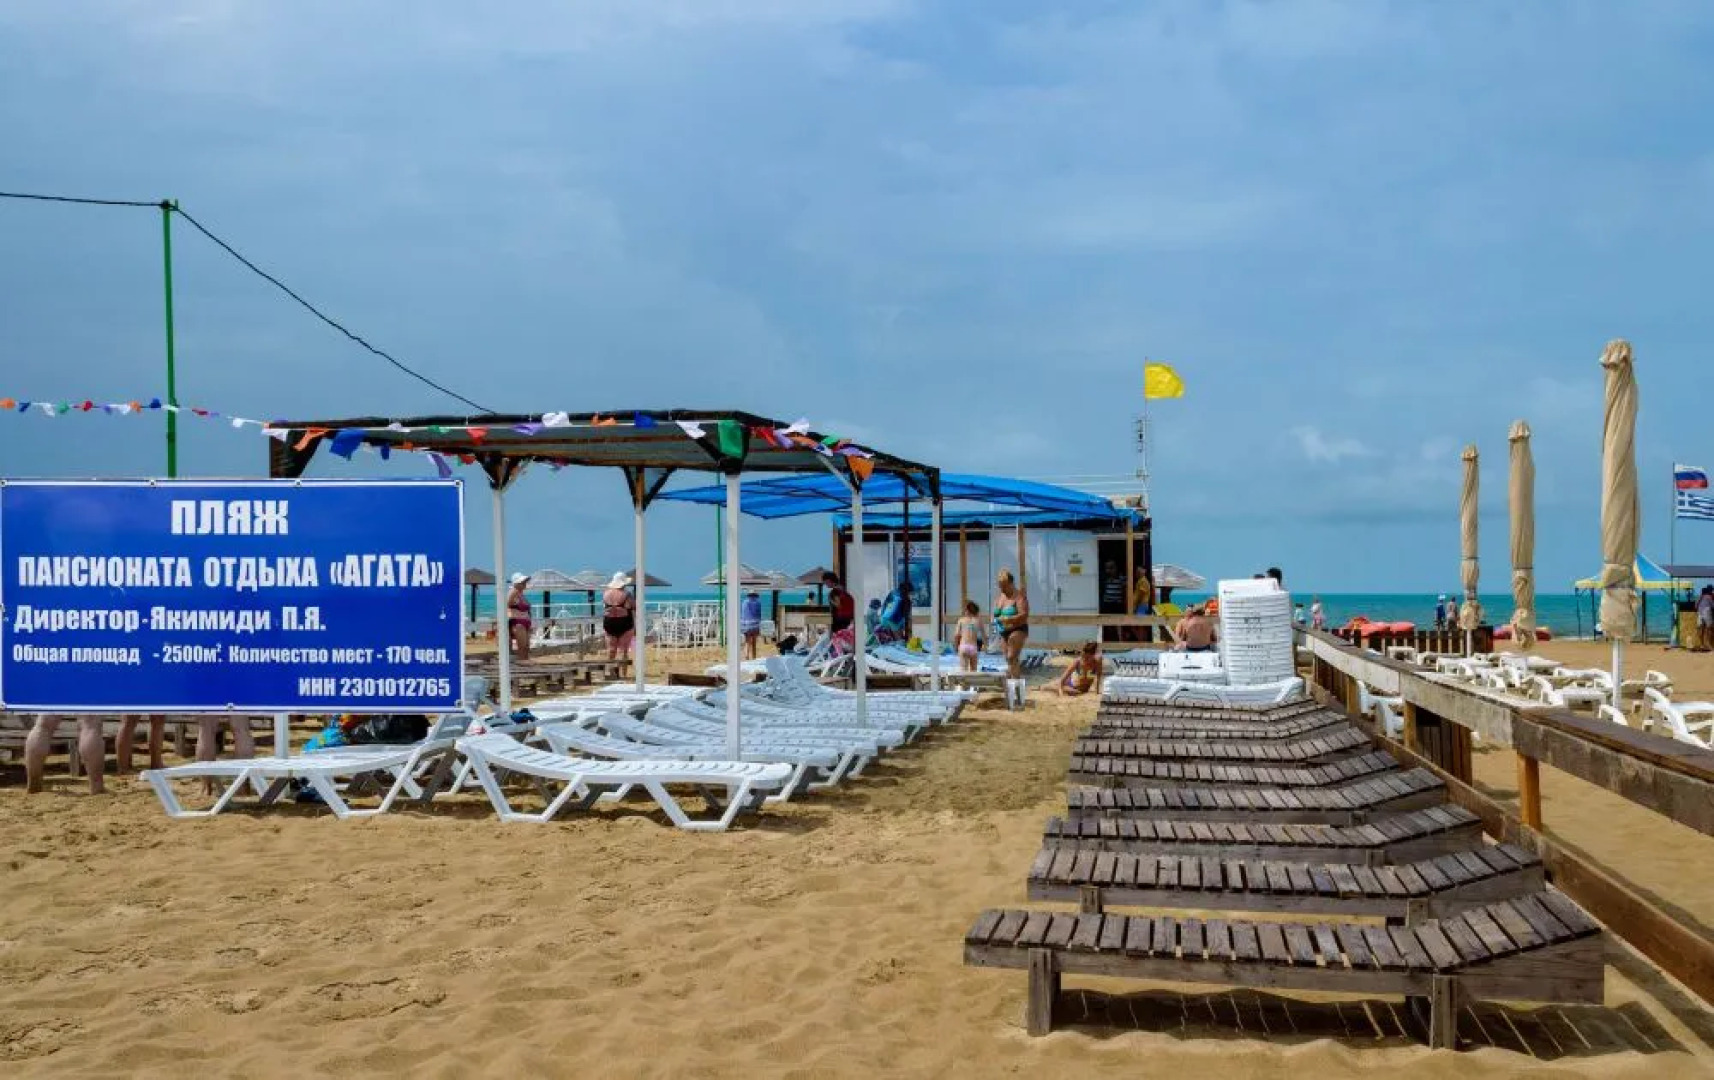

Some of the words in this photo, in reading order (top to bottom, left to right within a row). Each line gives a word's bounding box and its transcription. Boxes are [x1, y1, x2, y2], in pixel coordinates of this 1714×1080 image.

[171, 499, 289, 535] ПЛЯЖ
[18, 556, 193, 587] ПАНСИОНАТА
[203, 556, 319, 592] ОТДЫХА
[330, 554, 444, 587] «АГАТА»
[282, 606, 327, 631] П.Я.
[13, 644, 68, 665] Общая
[71, 647, 141, 665] площад
[229, 645, 329, 664] Количество
[332, 648, 374, 664] мест
[386, 645, 412, 664] 170
[415, 649, 450, 664] чел.
[298, 678, 336, 697] ИНН
[340, 678, 450, 697] 2301012765
